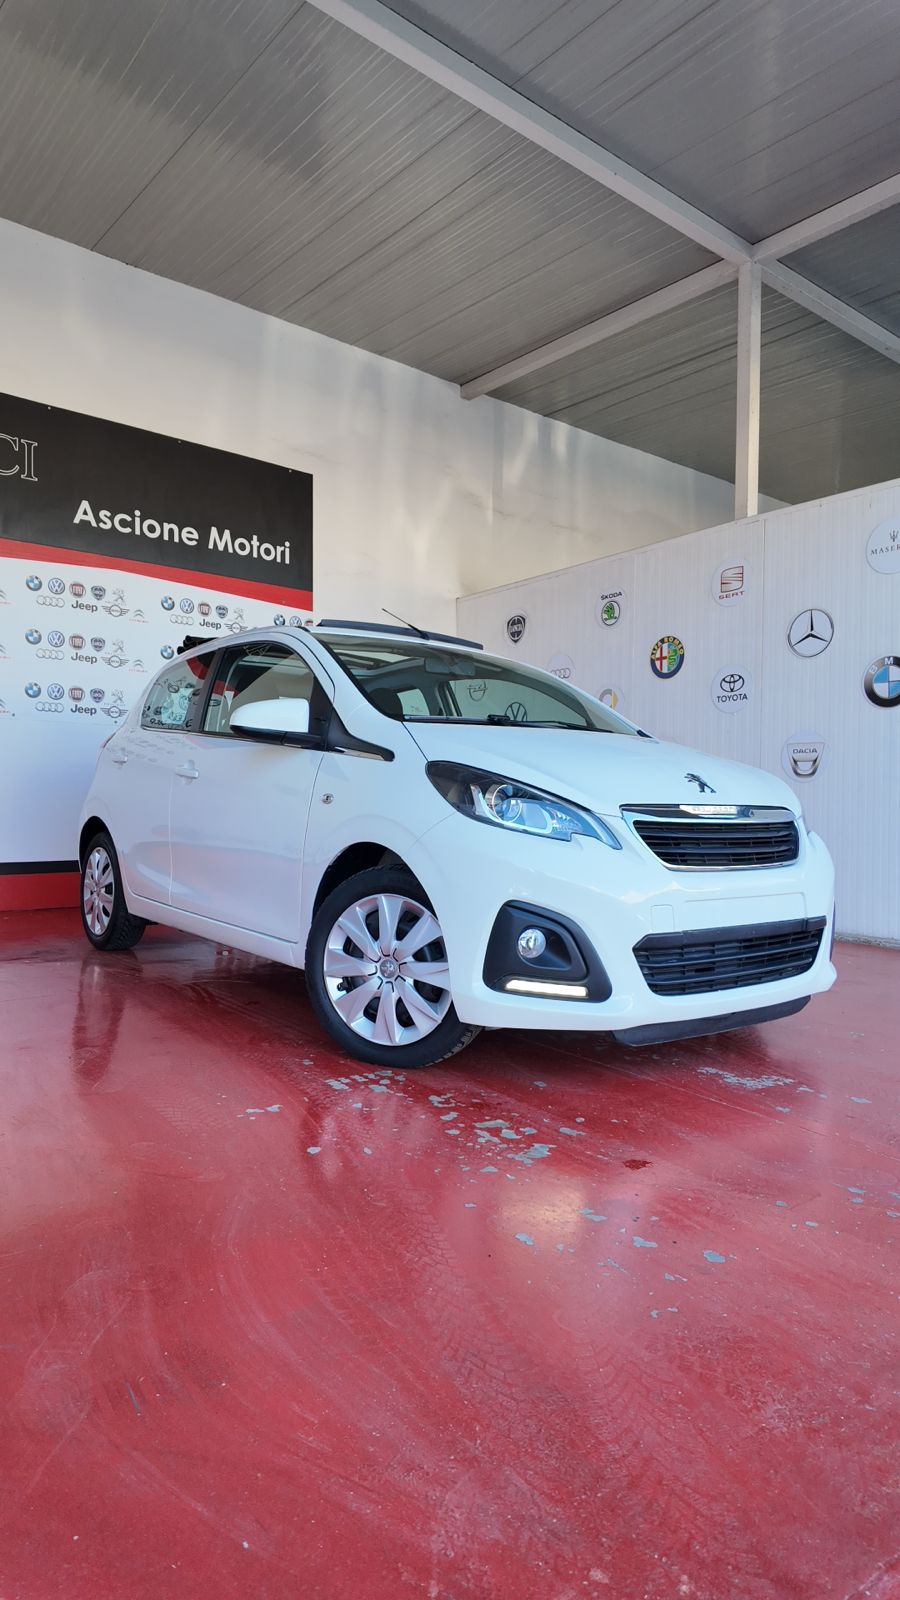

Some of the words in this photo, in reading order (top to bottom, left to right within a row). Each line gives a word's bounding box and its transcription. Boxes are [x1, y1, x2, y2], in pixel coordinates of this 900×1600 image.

[73, 500, 199, 546] Ascione
[208, 526, 290, 565] Motori
[71, 600, 98, 613] Jeep
[199, 618, 222, 631] Jeep
[71, 652, 98, 664] Jeep
[716, 693, 748, 703] TOYOTA
[70, 704, 97, 716] Jeep
